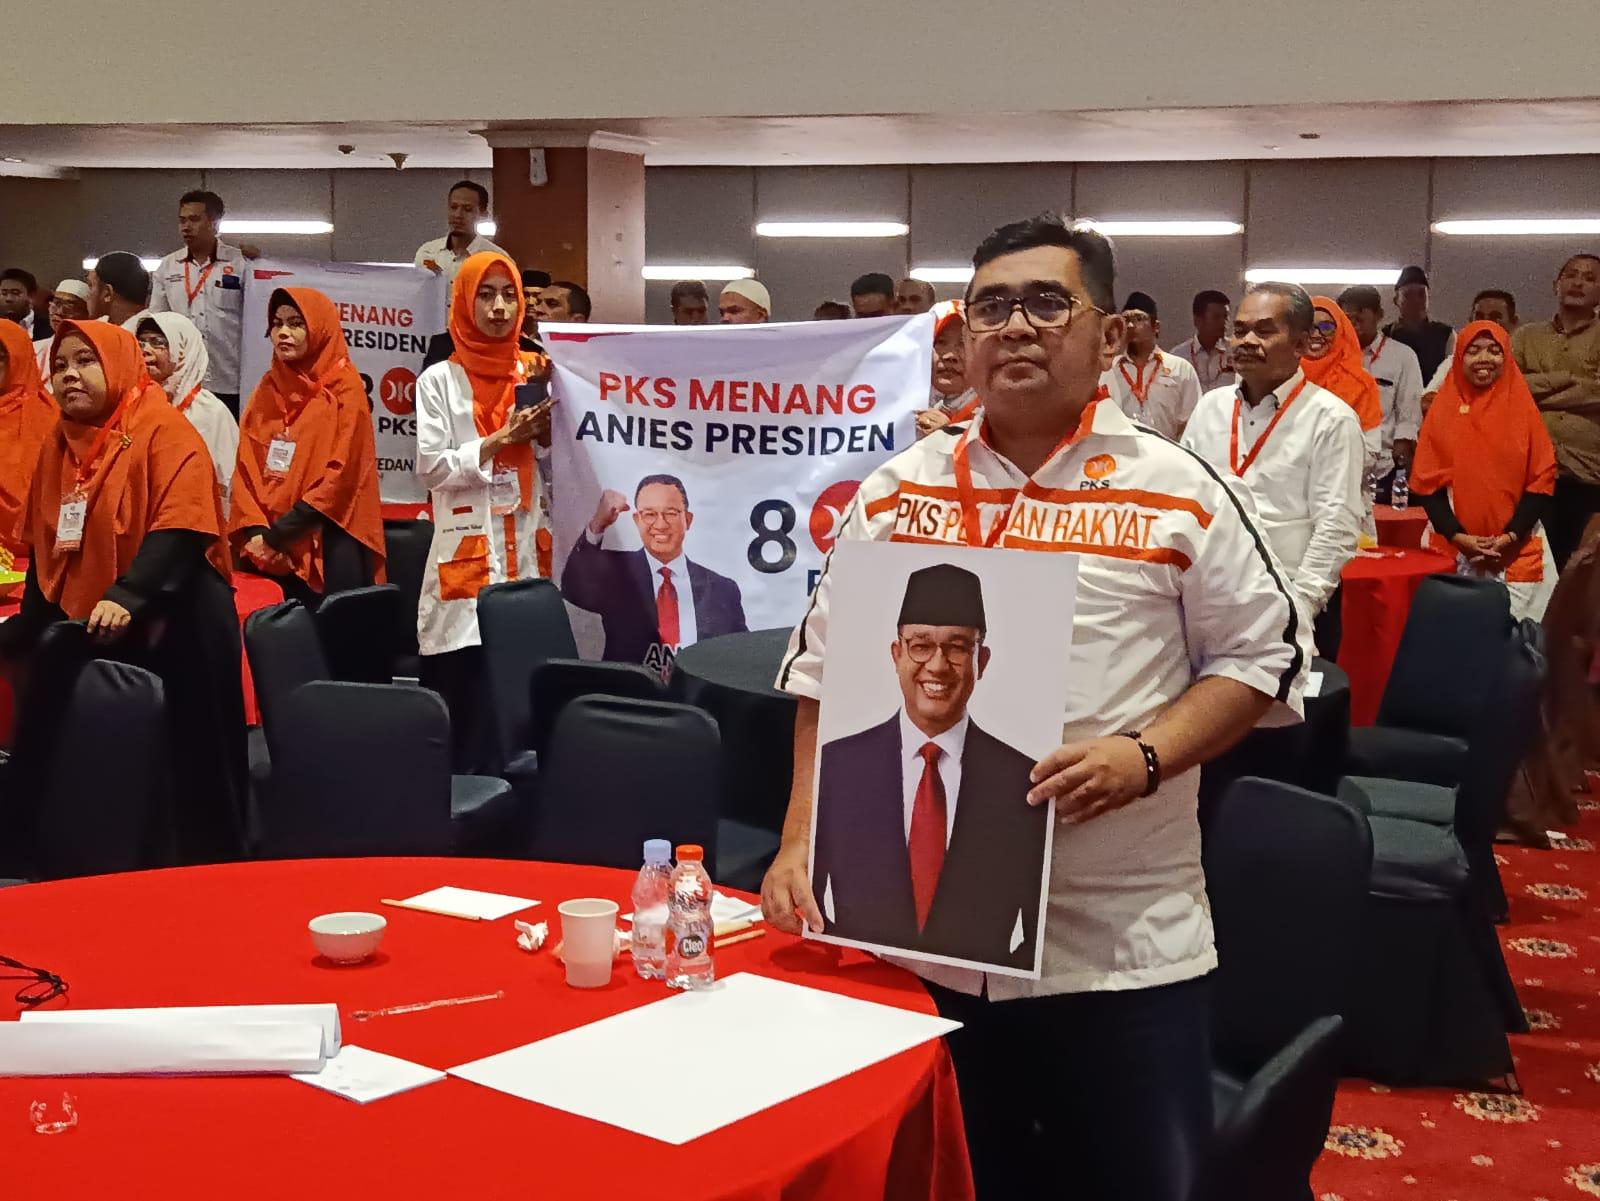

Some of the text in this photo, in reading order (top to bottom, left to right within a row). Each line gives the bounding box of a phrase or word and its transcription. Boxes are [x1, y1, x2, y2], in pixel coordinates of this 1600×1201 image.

[334, 302, 414, 328] ENANG
[600, 372, 876, 415] PKS MENANG
[576, 411, 894, 456] ANIES PRESIDEN
[376, 458, 414, 472] EDAN
[747, 499, 797, 574] 8
[894, 498, 942, 536] PKS
[1052, 508, 1159, 548] RAKYAT
